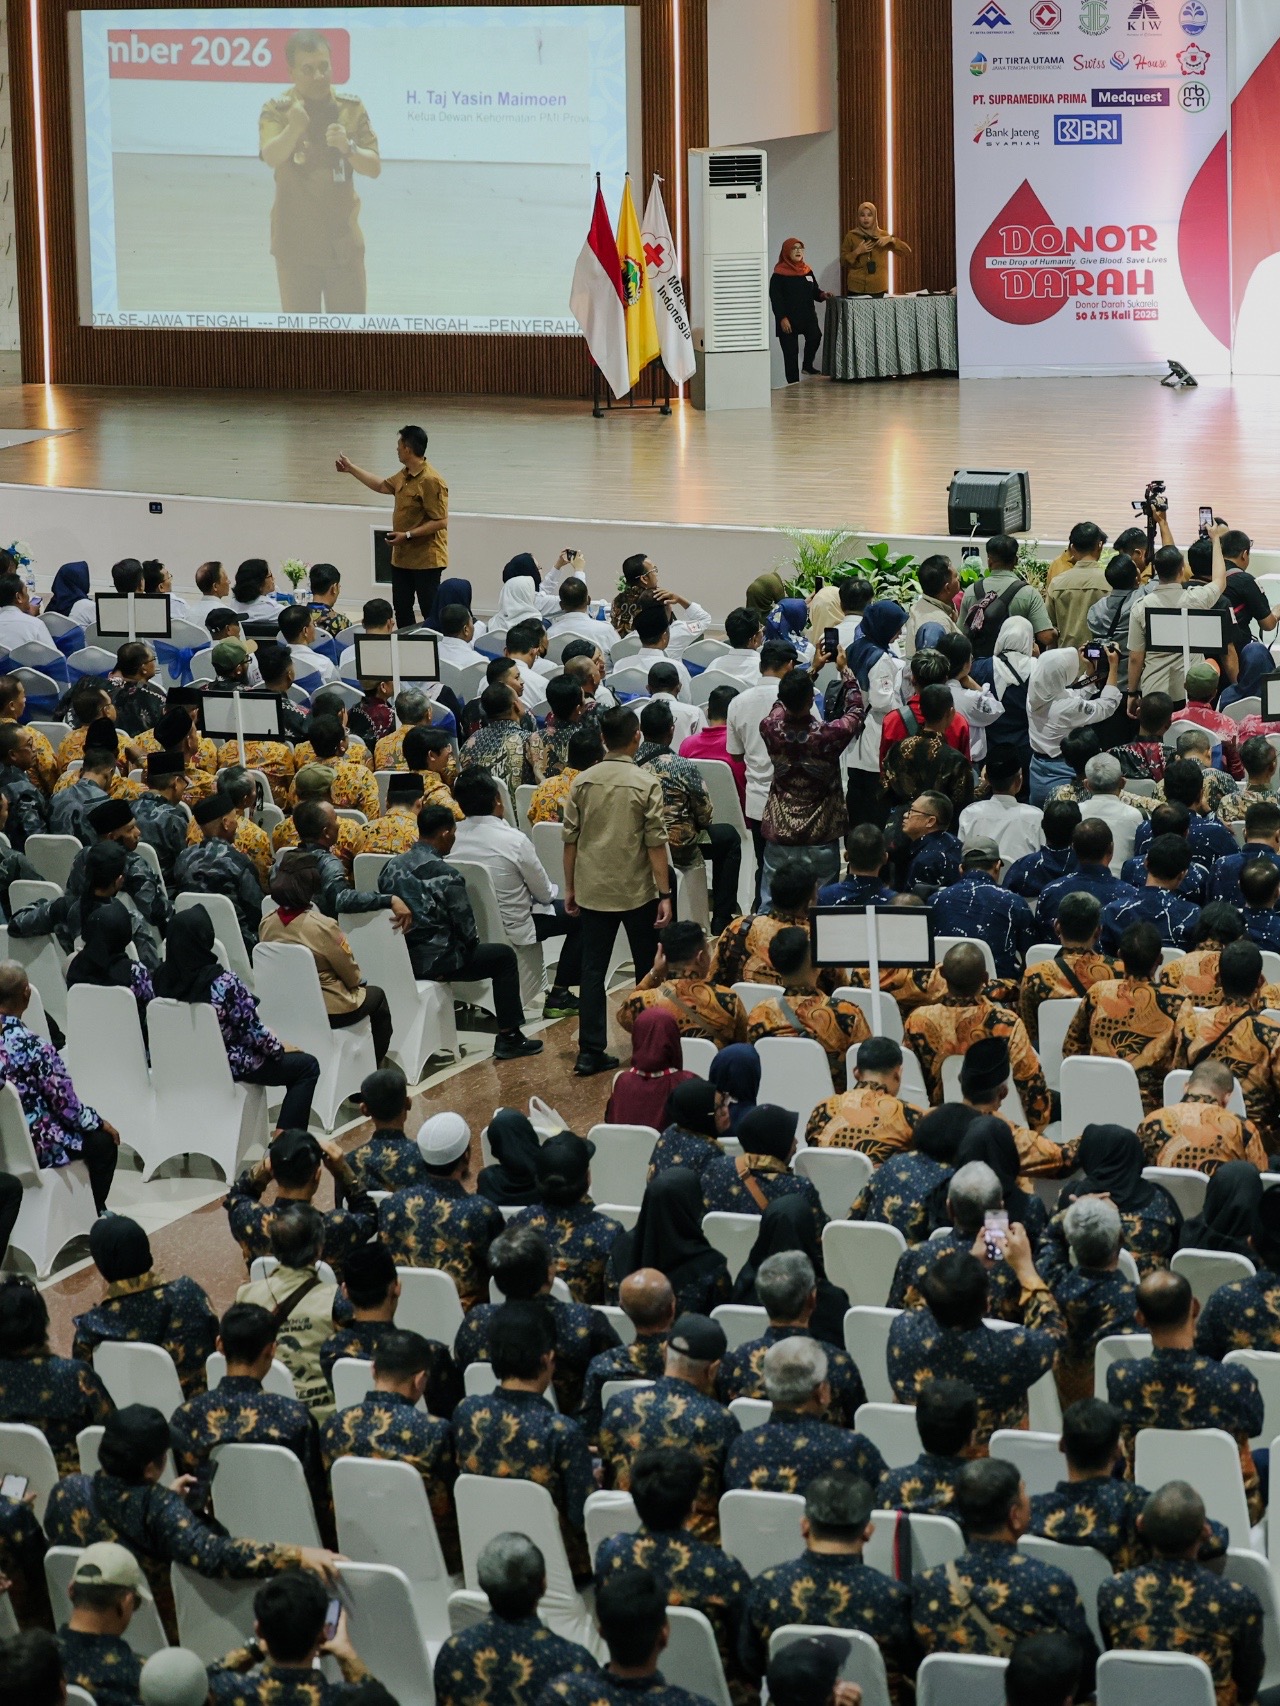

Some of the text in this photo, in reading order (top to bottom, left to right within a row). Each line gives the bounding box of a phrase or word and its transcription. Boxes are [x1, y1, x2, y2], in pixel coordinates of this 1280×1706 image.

[191, 36, 272, 67] 2026
[992, 56, 1065, 65] PT TIRTA UTAMA
[1073, 54, 1106, 71] Swiss
[406, 90, 567, 108] H. Taj Yasin Maimoen
[973, 93, 1087, 105] PT. SUPRAMEDIKA PRIMA
[1098, 91, 1163, 105] Medquest
[985, 127, 1039, 139] Bank Jateng
[1081, 120, 1118, 141] BRI
[999, 224, 1158, 255] DONOR
[991, 258, 1008, 266] One
[1009, 258, 1028, 267] Drop
[1080, 257, 1098, 265] Give
[1126, 256, 1145, 264] Save
[1146, 256, 1168, 264] Lives
[1000, 268, 1155, 300] DARAH
[657, 284, 691, 340] Indonesia
[1075, 300, 1159, 309] Donor Darah Sukarela
[118, 313, 183, 327] SE-JAWA
[186, 314, 249, 328] TENGAH
[277, 316, 304, 329] PMI
[309, 316, 354, 329] PROV.
[359, 317, 400, 330] JAWA
[404, 317, 469, 331] TENGAH
[1075, 312, 1088, 320] 50
[1089, 312, 1097, 320] &
[1098, 312, 1109, 320] 75
[1111, 310, 1131, 320] Kali
